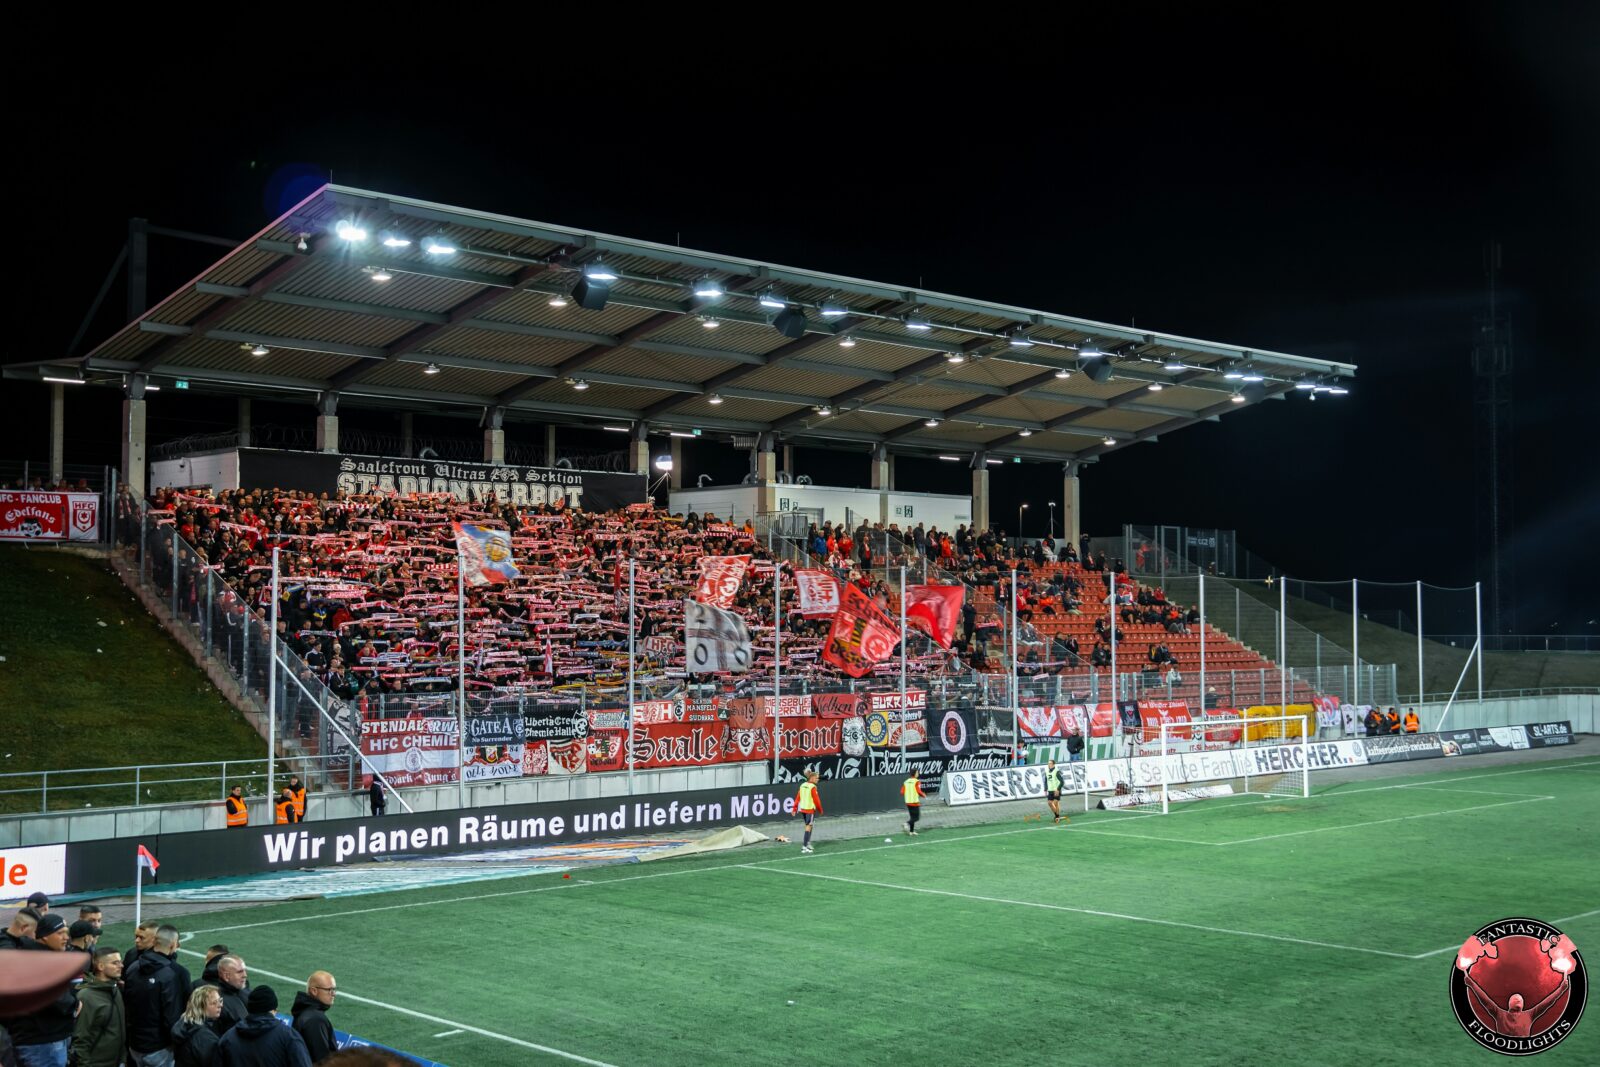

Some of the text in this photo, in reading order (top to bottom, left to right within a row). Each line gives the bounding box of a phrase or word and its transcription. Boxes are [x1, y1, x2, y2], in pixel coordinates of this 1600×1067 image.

[340, 457, 582, 484] Saalefront Ultras Sektion
[20, 493, 62, 504] FANCLUB
[337, 472, 584, 508] STADIONVERBOT
[5, 506, 57, 524] Edelfans
[872, 693, 926, 709] SURRALE
[361, 719, 424, 734] STENDAL
[369, 734, 457, 752] HFC CHEMIE
[624, 728, 718, 763] Saale
[773, 720, 840, 753] front
[1140, 760, 1198, 783] Sevice
[264, 831, 325, 864] Wir
[336, 826, 448, 863] planen
[459, 815, 565, 845] Räume
[574, 804, 626, 834] und
[635, 801, 722, 828] liefern
